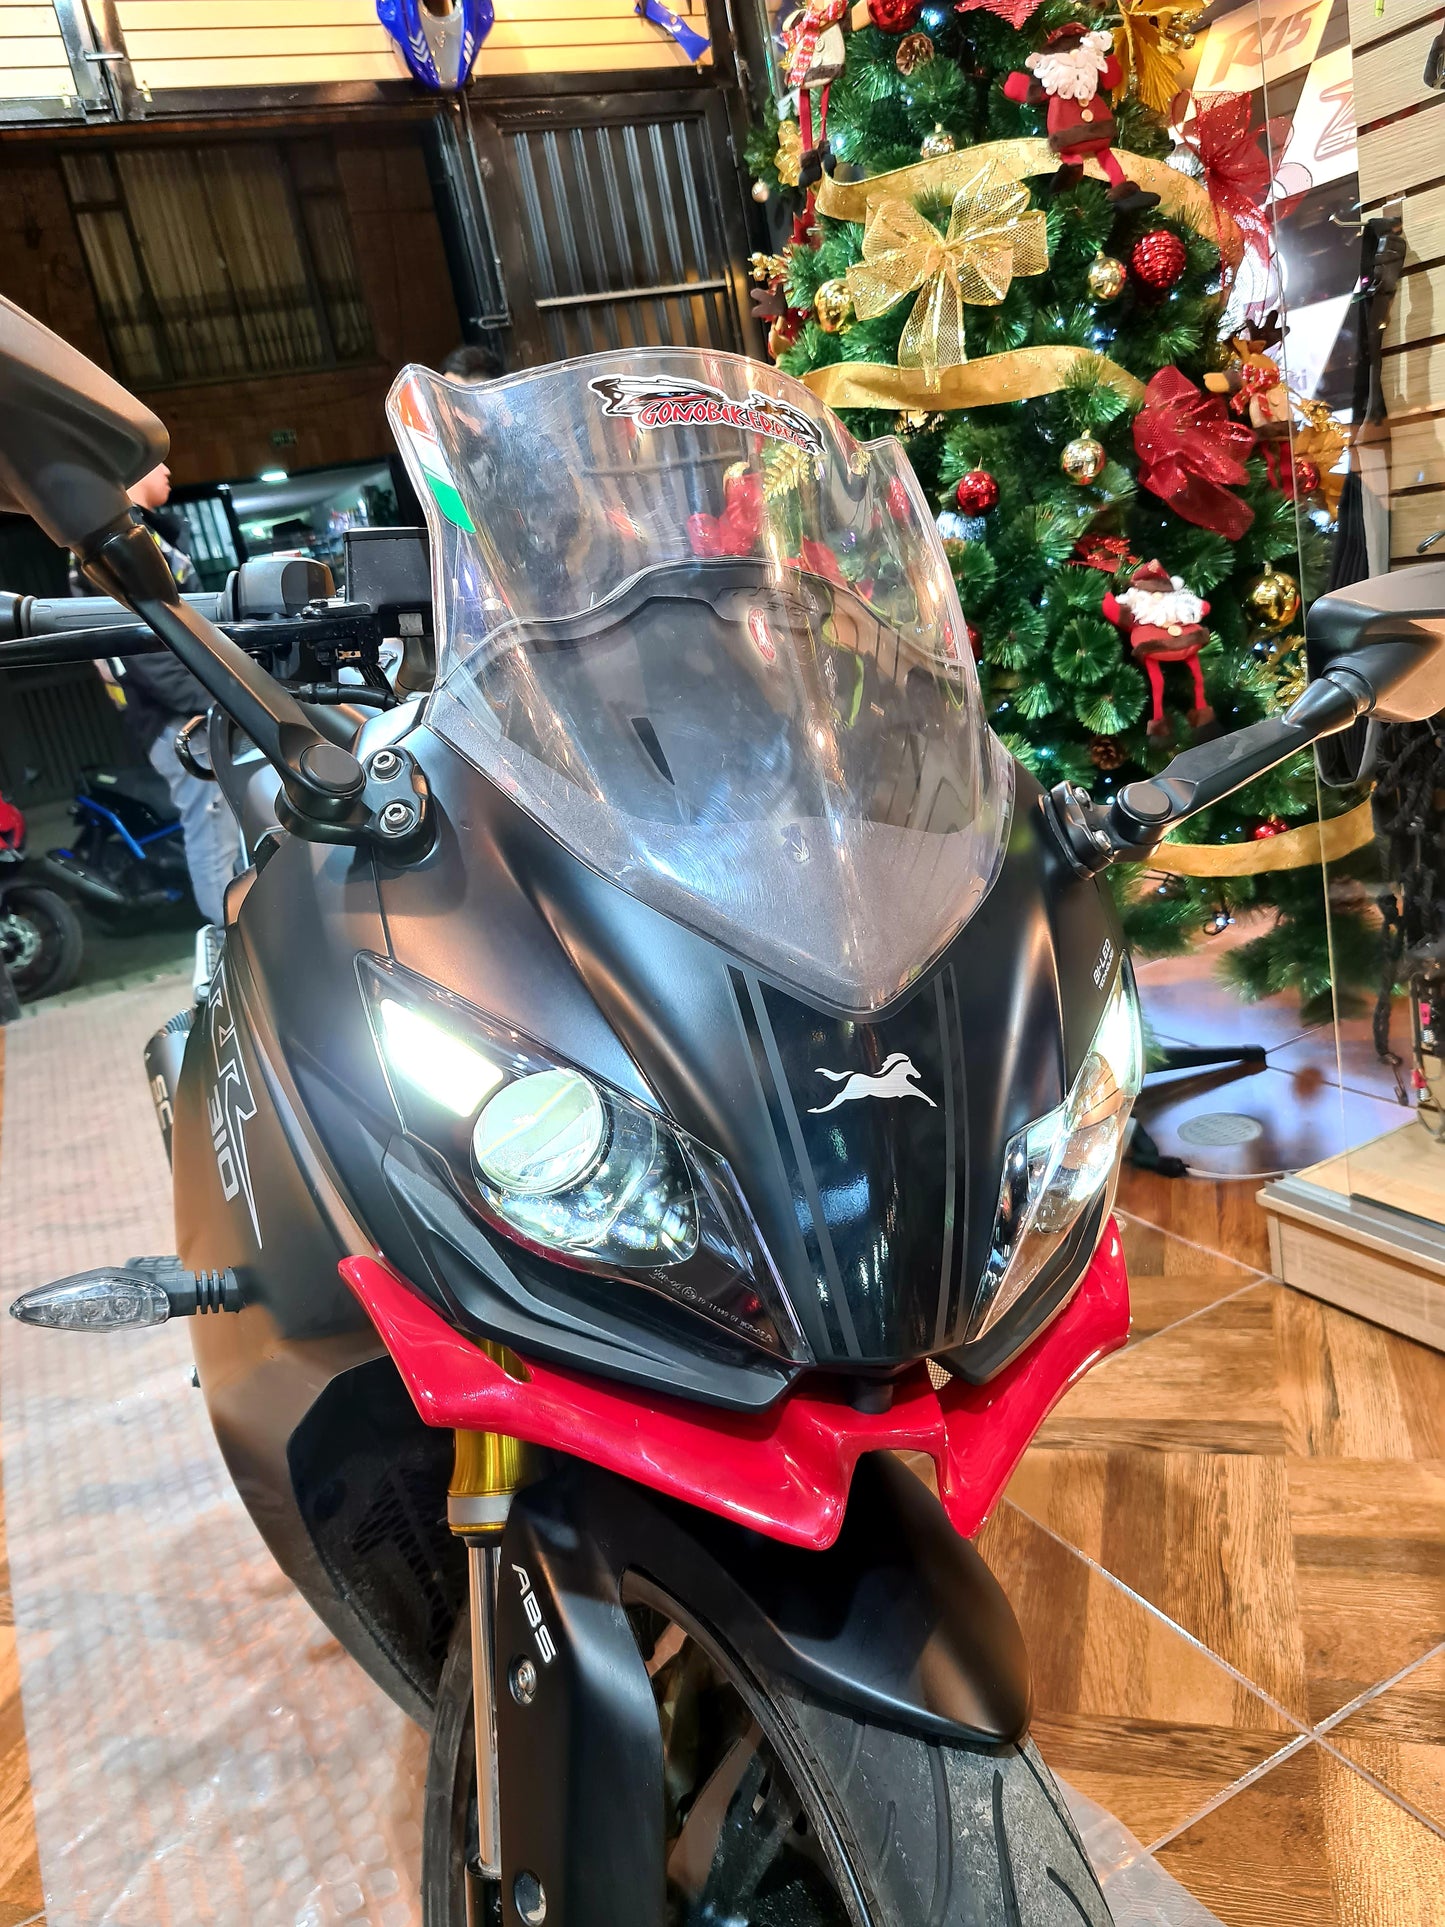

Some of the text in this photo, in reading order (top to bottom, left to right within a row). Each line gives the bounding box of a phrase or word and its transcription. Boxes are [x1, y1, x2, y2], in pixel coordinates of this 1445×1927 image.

[1209, 1, 1320, 87] R15
[1093, 937, 1111, 985] BI-LED
[206, 1084, 240, 1202] 310
[511, 1563, 557, 1664] ABS
